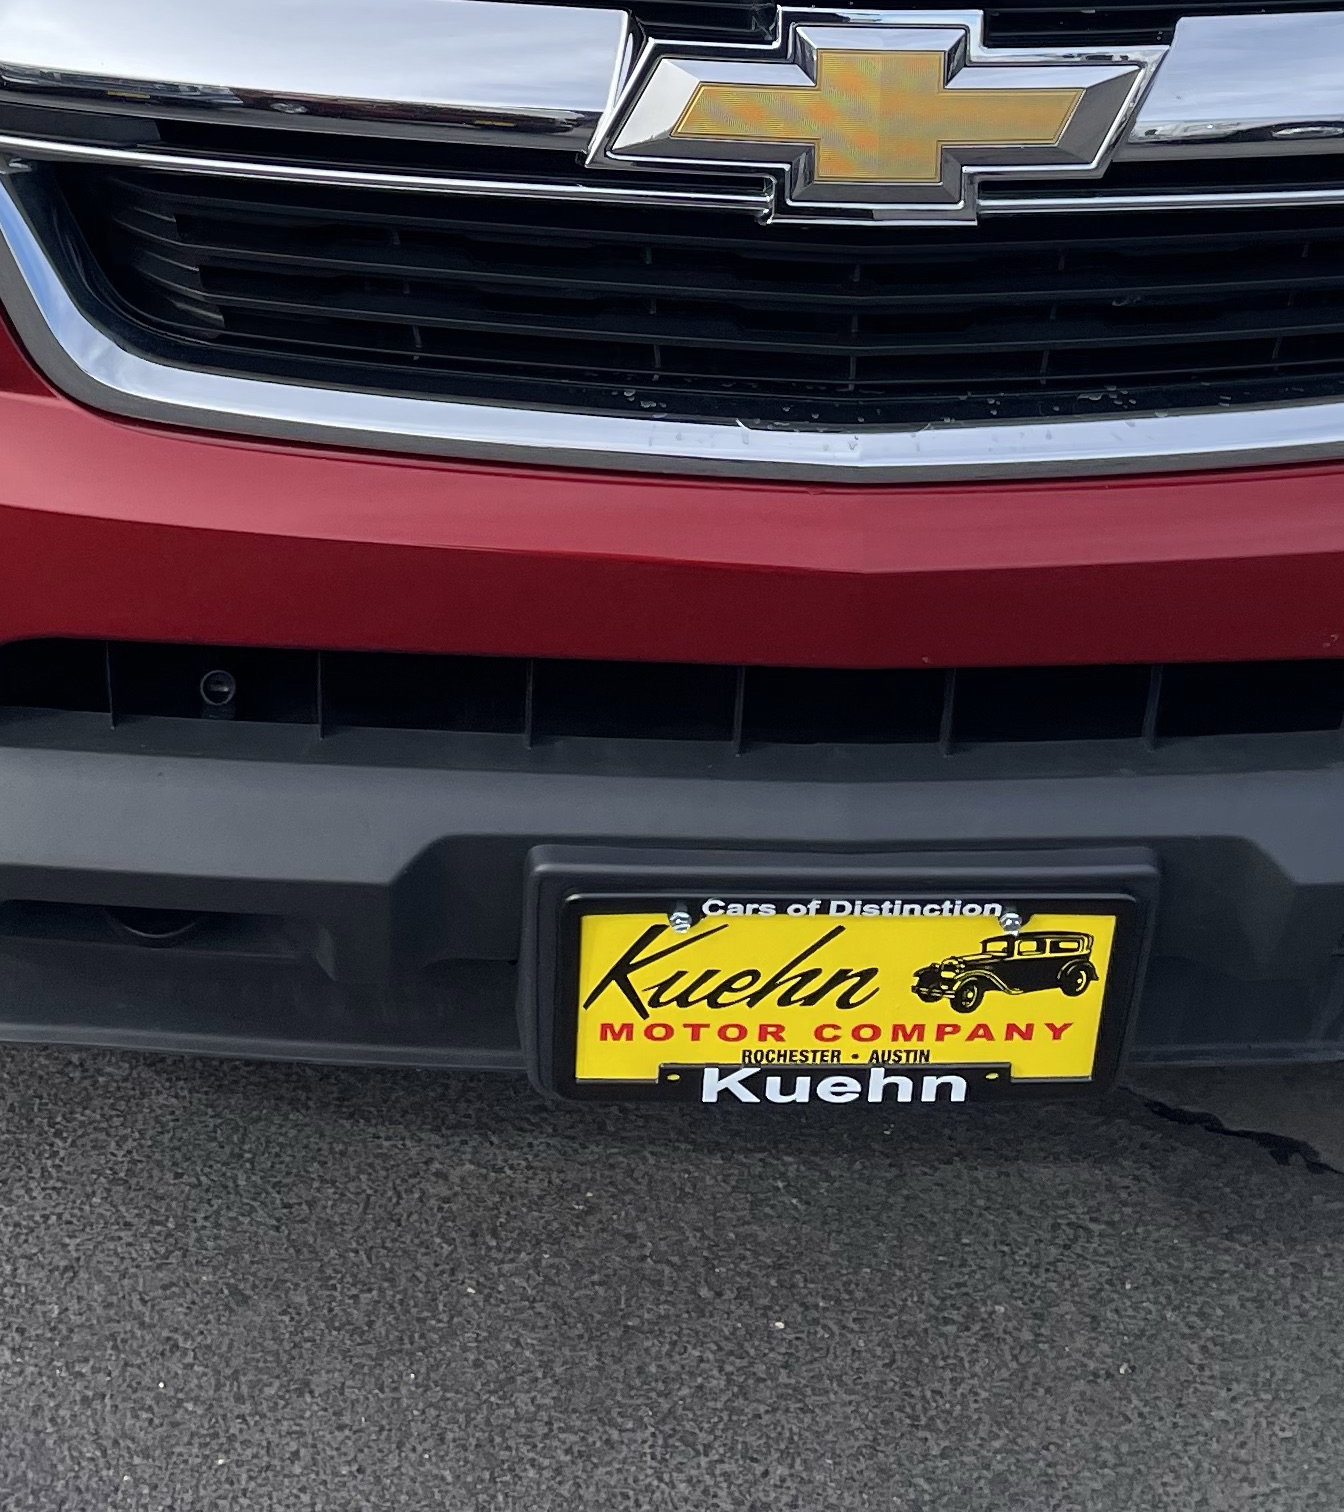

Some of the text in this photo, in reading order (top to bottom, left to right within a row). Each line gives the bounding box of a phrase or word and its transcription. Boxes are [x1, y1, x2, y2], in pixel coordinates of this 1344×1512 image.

[702, 898, 1003, 918] Cars of Distinction
[583, 923, 881, 1021] Kuehn
[599, 1022, 1074, 1043] MOTOR COMPANY
[741, 1048, 931, 1065] ROCHESTER AUSTIN
[701, 1067, 968, 1104] Kuehn
